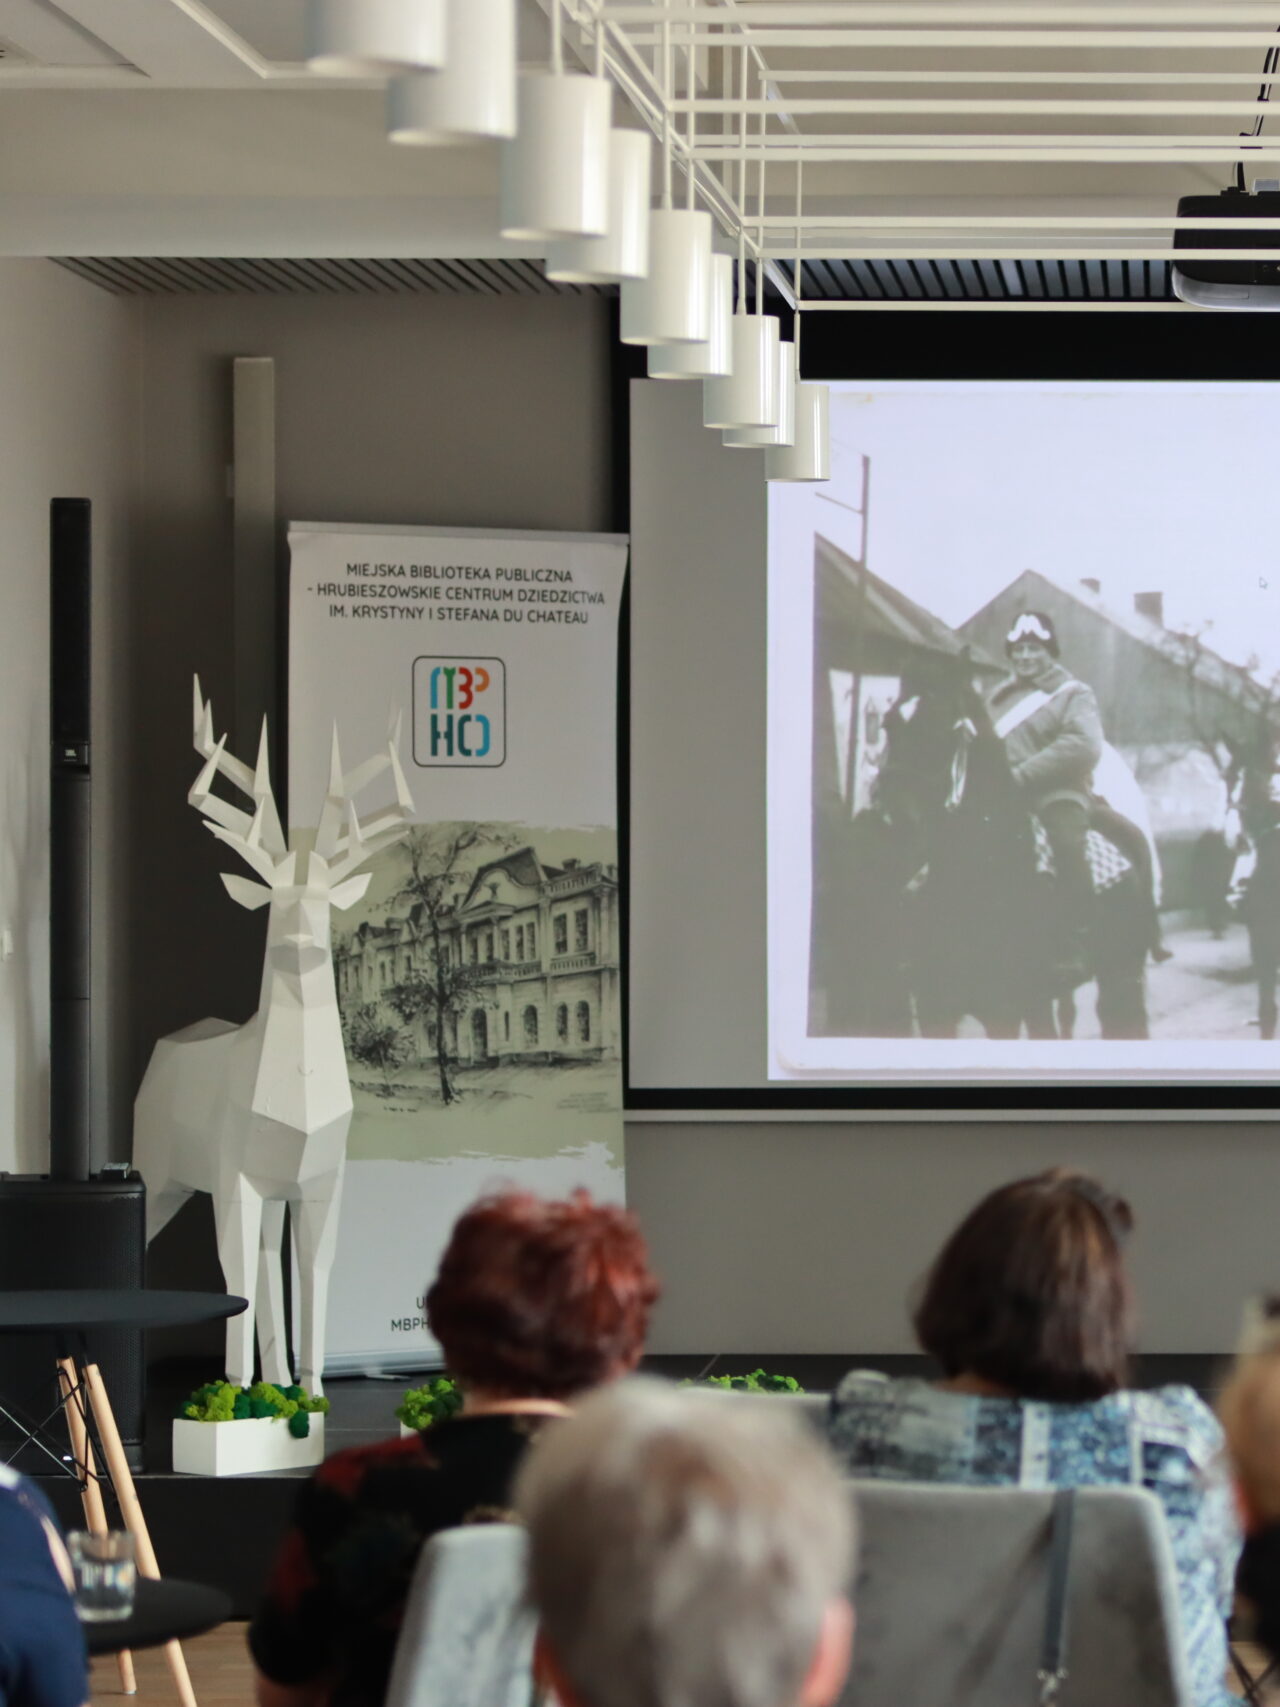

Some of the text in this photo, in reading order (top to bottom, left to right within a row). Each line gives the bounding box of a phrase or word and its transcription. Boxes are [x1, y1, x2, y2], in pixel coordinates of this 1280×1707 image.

[347, 564, 572, 582] MIEJSKA BIBLIOTEKA PUBLICZNA
[318, 583, 440, 599] HRUBIESZOWSKIE
[446, 587, 513, 601] CENTRUM
[518, 589, 604, 604] DZIEDZICTWA
[330, 605, 348, 617] IM.
[353, 605, 424, 619] KRYSTYNY
[437, 607, 499, 621] STEFANA
[504, 609, 522, 622] DU
[527, 610, 587, 623] CHATEAU
